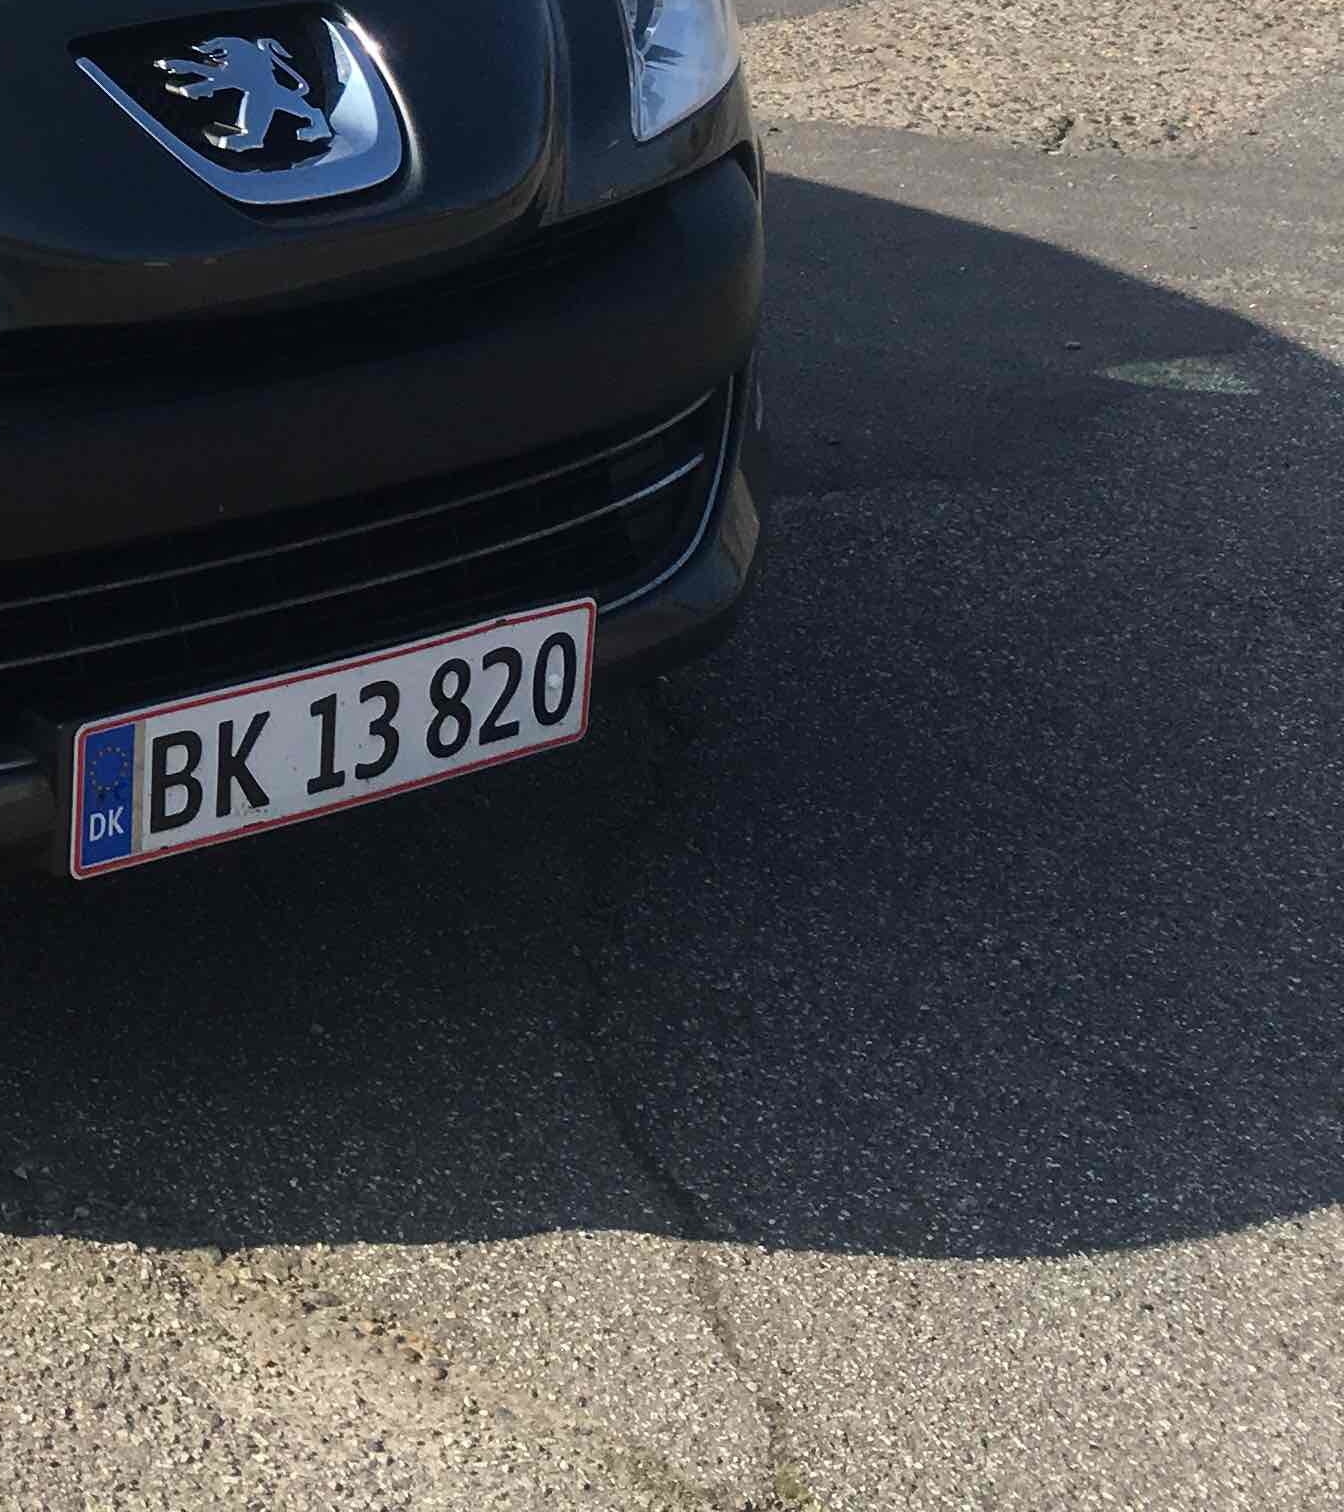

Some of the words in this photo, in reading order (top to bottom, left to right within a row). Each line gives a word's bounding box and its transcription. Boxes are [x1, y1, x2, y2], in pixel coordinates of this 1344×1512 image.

[150, 711, 270, 834] BK
[306, 680, 401, 795] 13
[425, 632, 577, 759] 820
[89, 805, 125, 843] DK
